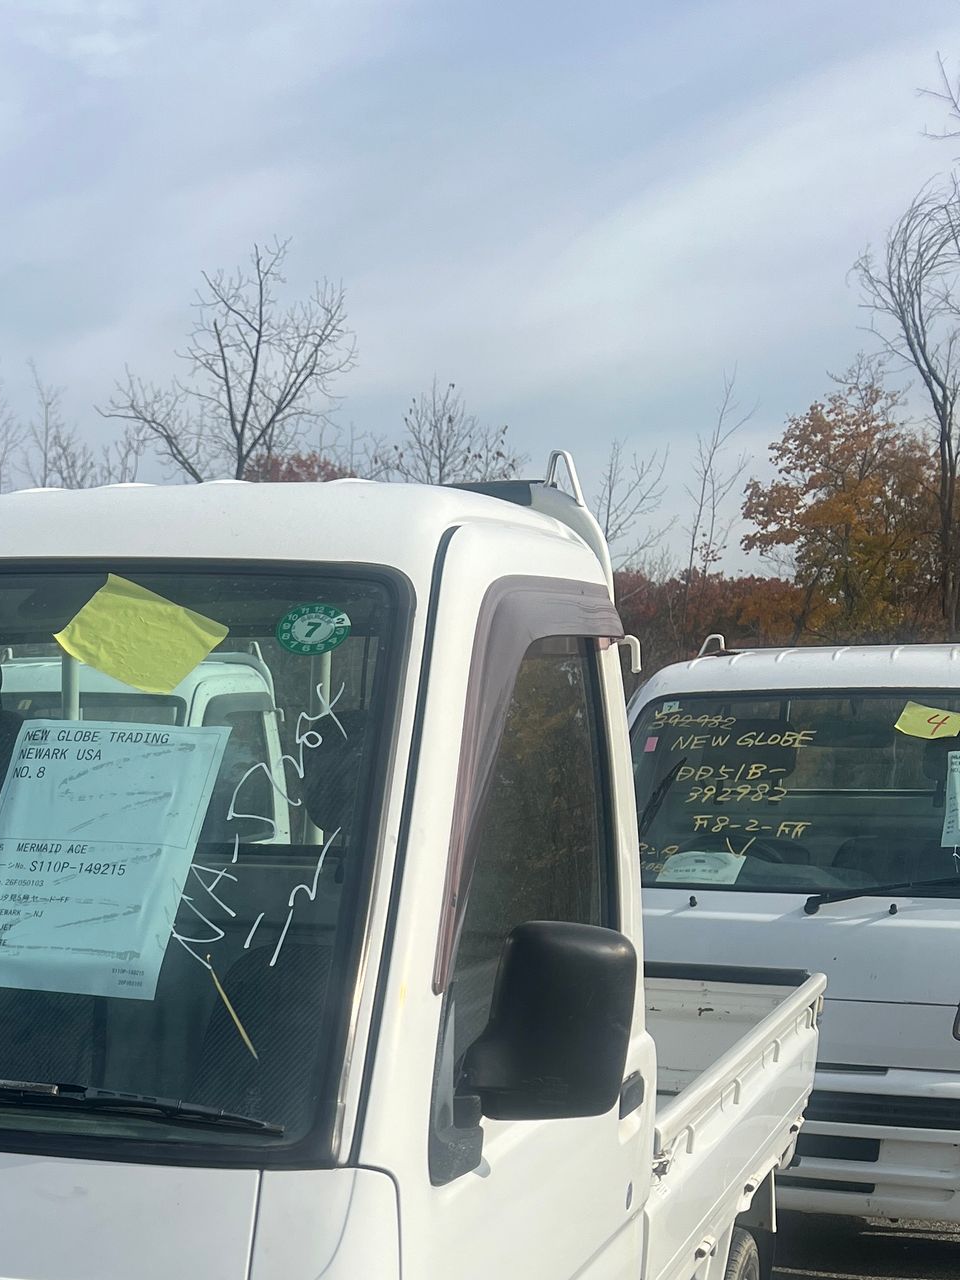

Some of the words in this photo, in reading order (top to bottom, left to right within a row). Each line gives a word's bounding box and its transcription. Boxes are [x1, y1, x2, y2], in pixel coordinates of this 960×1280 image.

[335, 617, 346, 625] 2
[304, 621, 322, 638] 7
[927, 714, 950, 736] 4
[24, 730, 51, 741] NEW
[57, 730, 100, 742] GLOBE
[109, 732, 170, 744] TRADING
[671, 735, 730, 751] NEW
[736, 731, 817, 748] GLOBE
[19, 748, 69, 760] NEWARK
[76, 749, 102, 761] USA
[16, 843, 62, 854] MERMAID
[67, 844, 88, 854] ACE
[29, 860, 127, 876] S110P-149215
